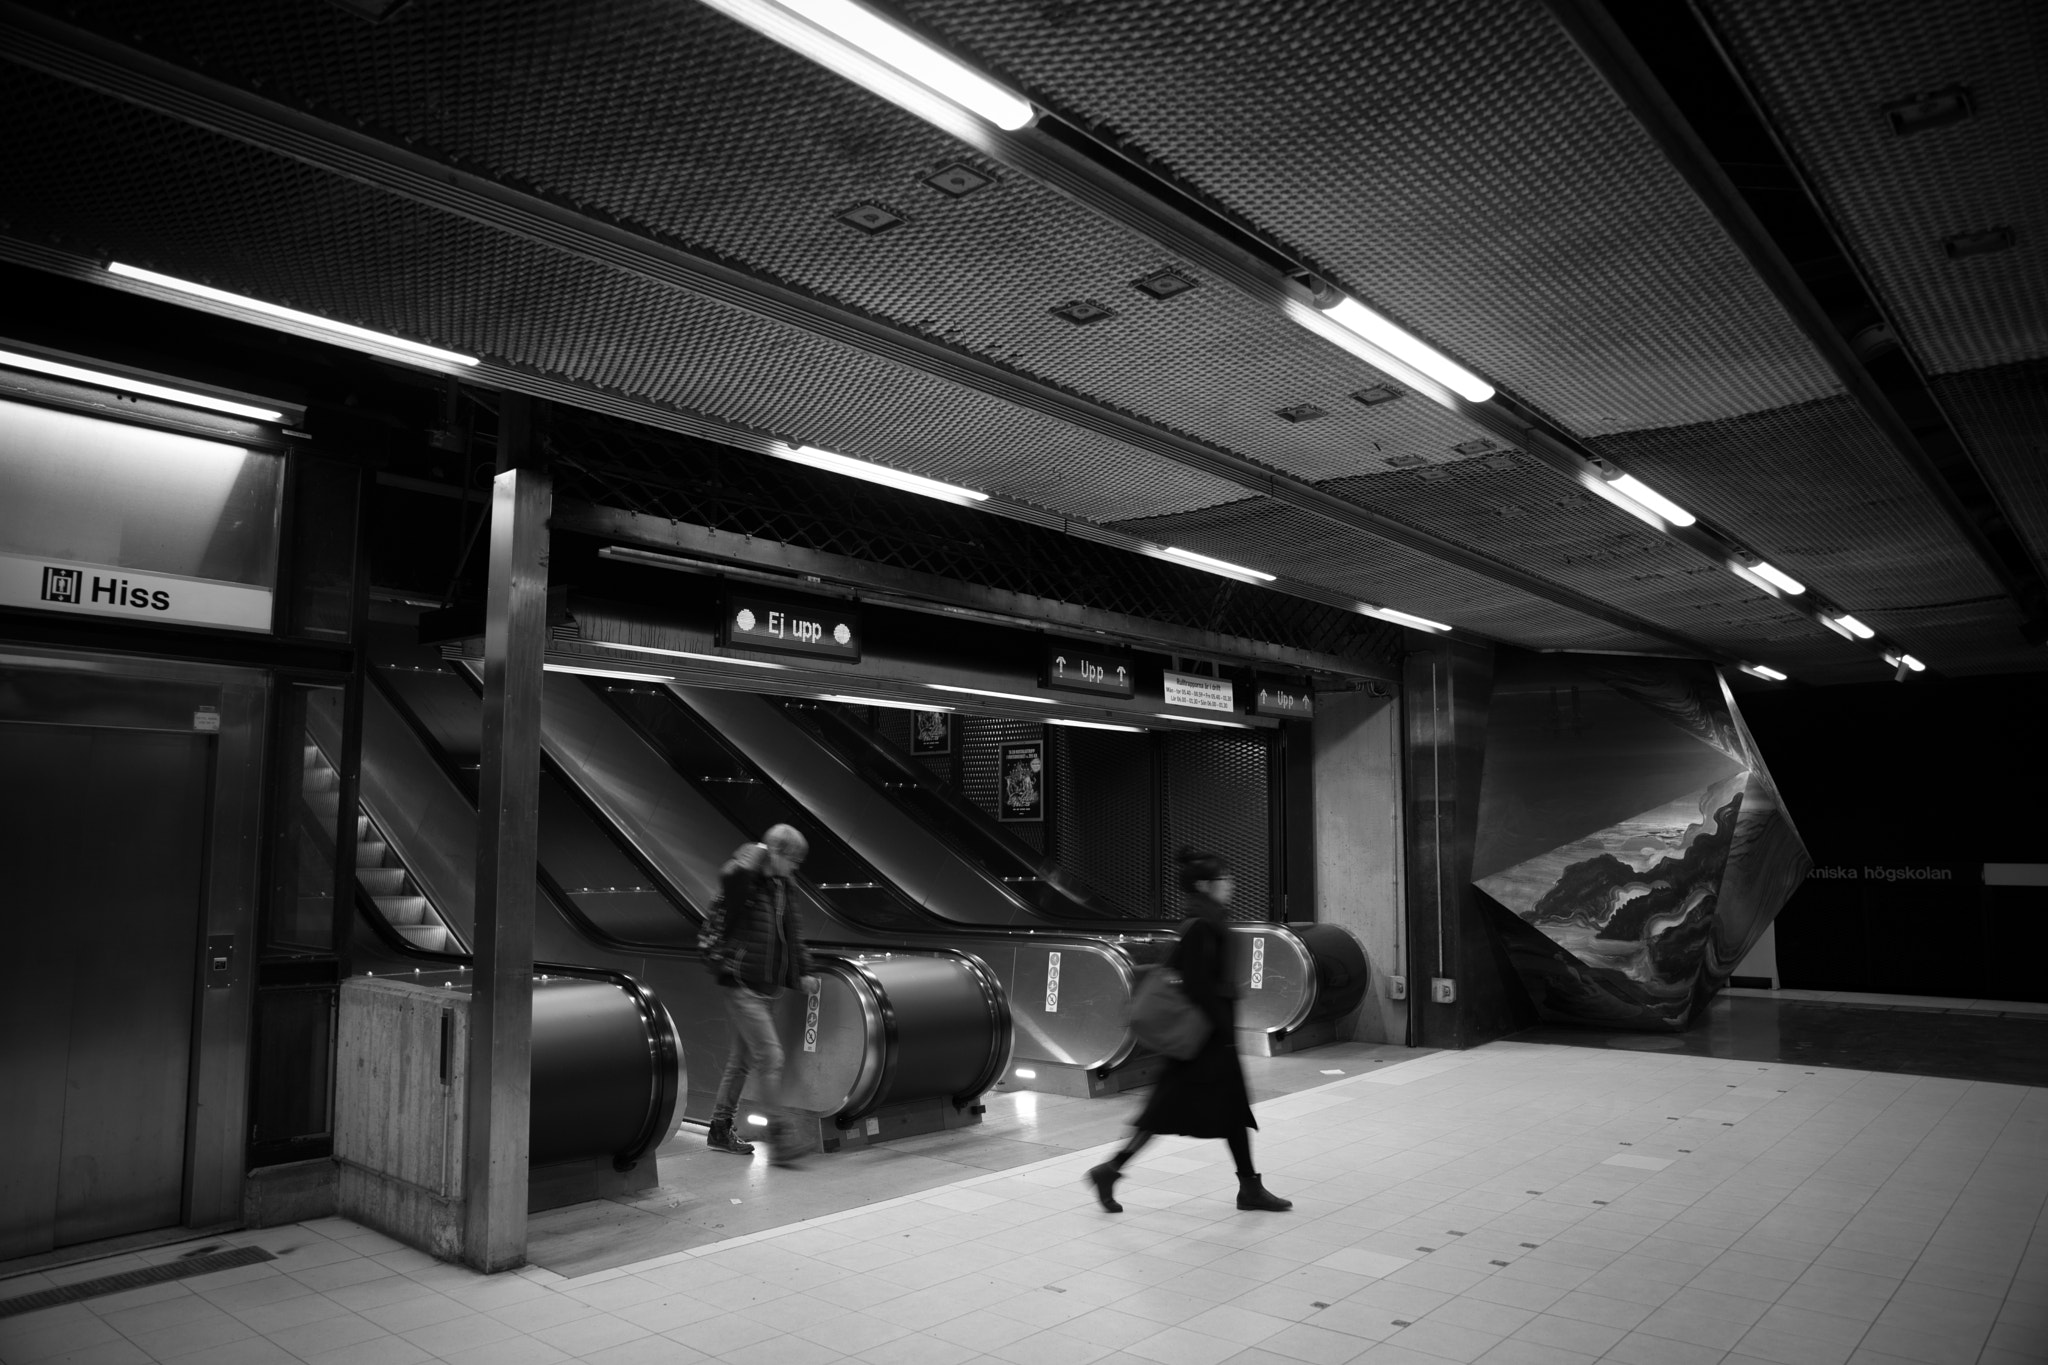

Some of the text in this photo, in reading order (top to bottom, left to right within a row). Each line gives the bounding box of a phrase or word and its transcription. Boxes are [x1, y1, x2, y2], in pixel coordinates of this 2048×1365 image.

[91, 576, 170, 611] Hiss
[768, 611, 822, 644] Ej upp
[1080, 659, 1104, 683] Upp
[1277, 690, 1294, 709] Upp
[1863, 865, 1952, 882] högskolan
